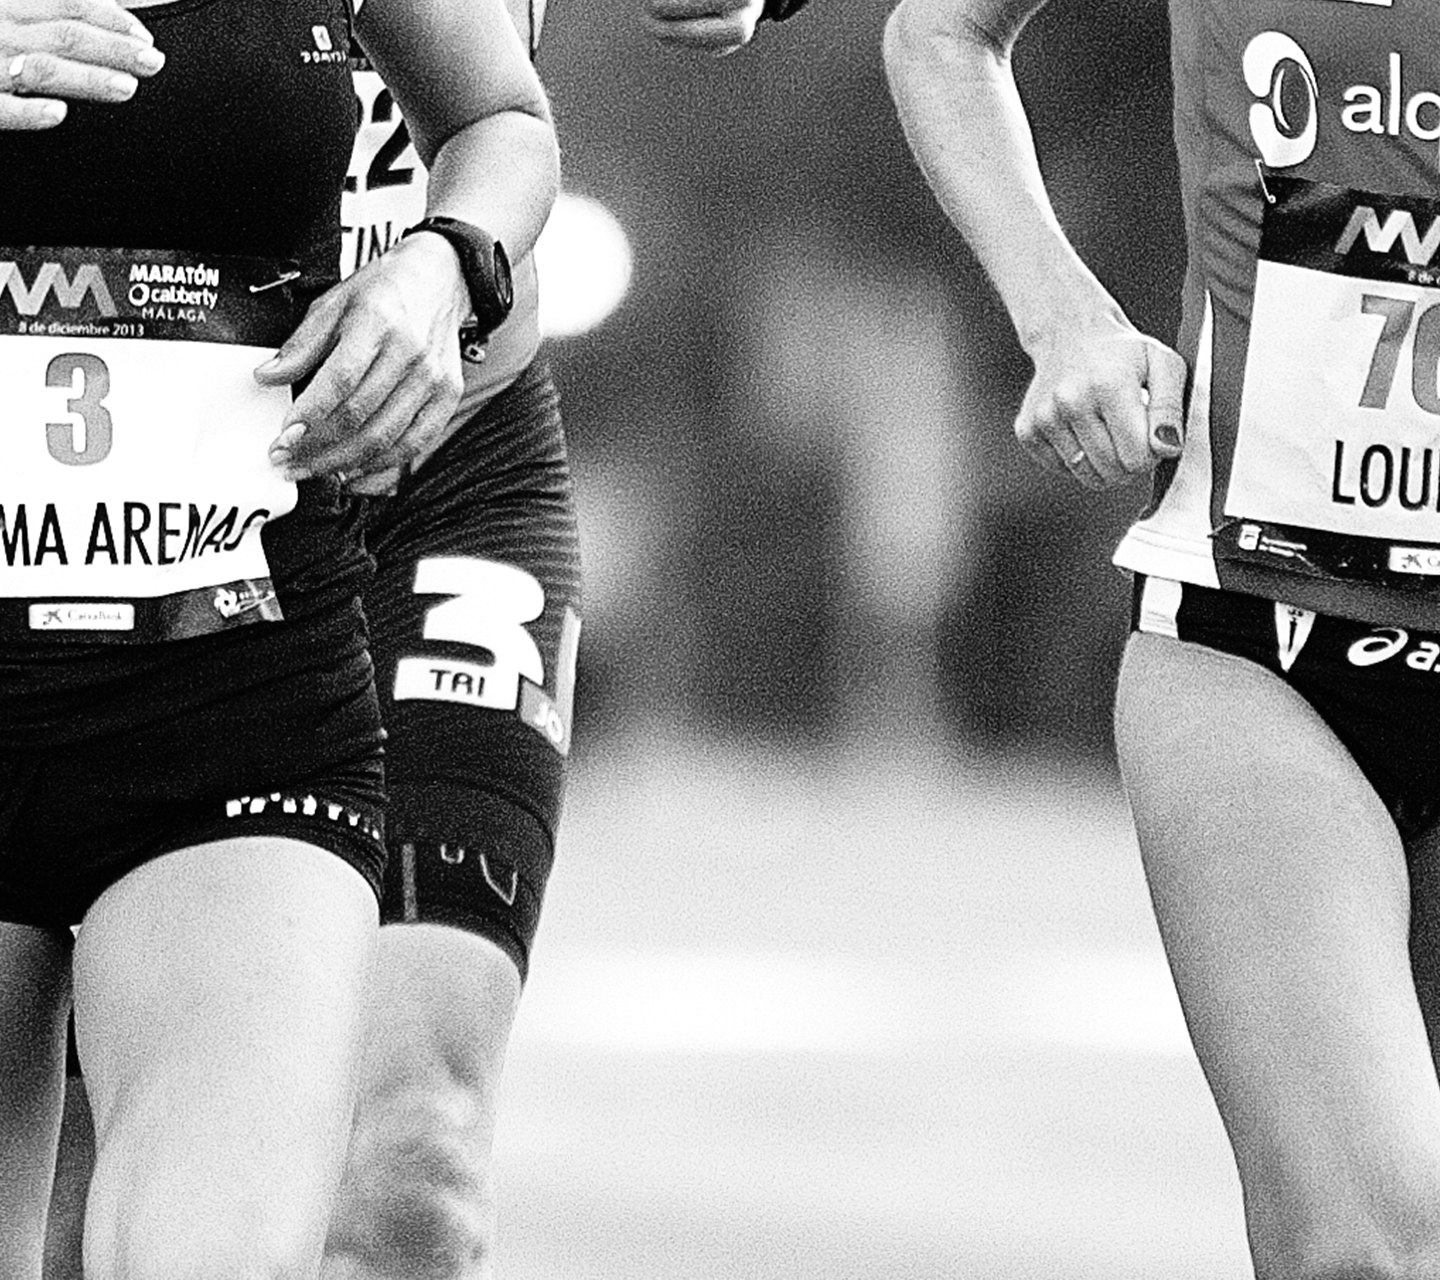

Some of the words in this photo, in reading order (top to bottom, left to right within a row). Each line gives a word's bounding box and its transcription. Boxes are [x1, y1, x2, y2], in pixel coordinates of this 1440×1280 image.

[128, 263, 220, 287] MARATÓN
[141, 305, 208, 323] MÁLAGA
[28, 320, 46, 334] de
[47, 321, 110, 336] diciembre
[112, 323, 145, 337] 2013
[45, 352, 113, 467] 3
[84, 502, 271, 566] ARENAS
[429, 668, 486, 698] TRI
